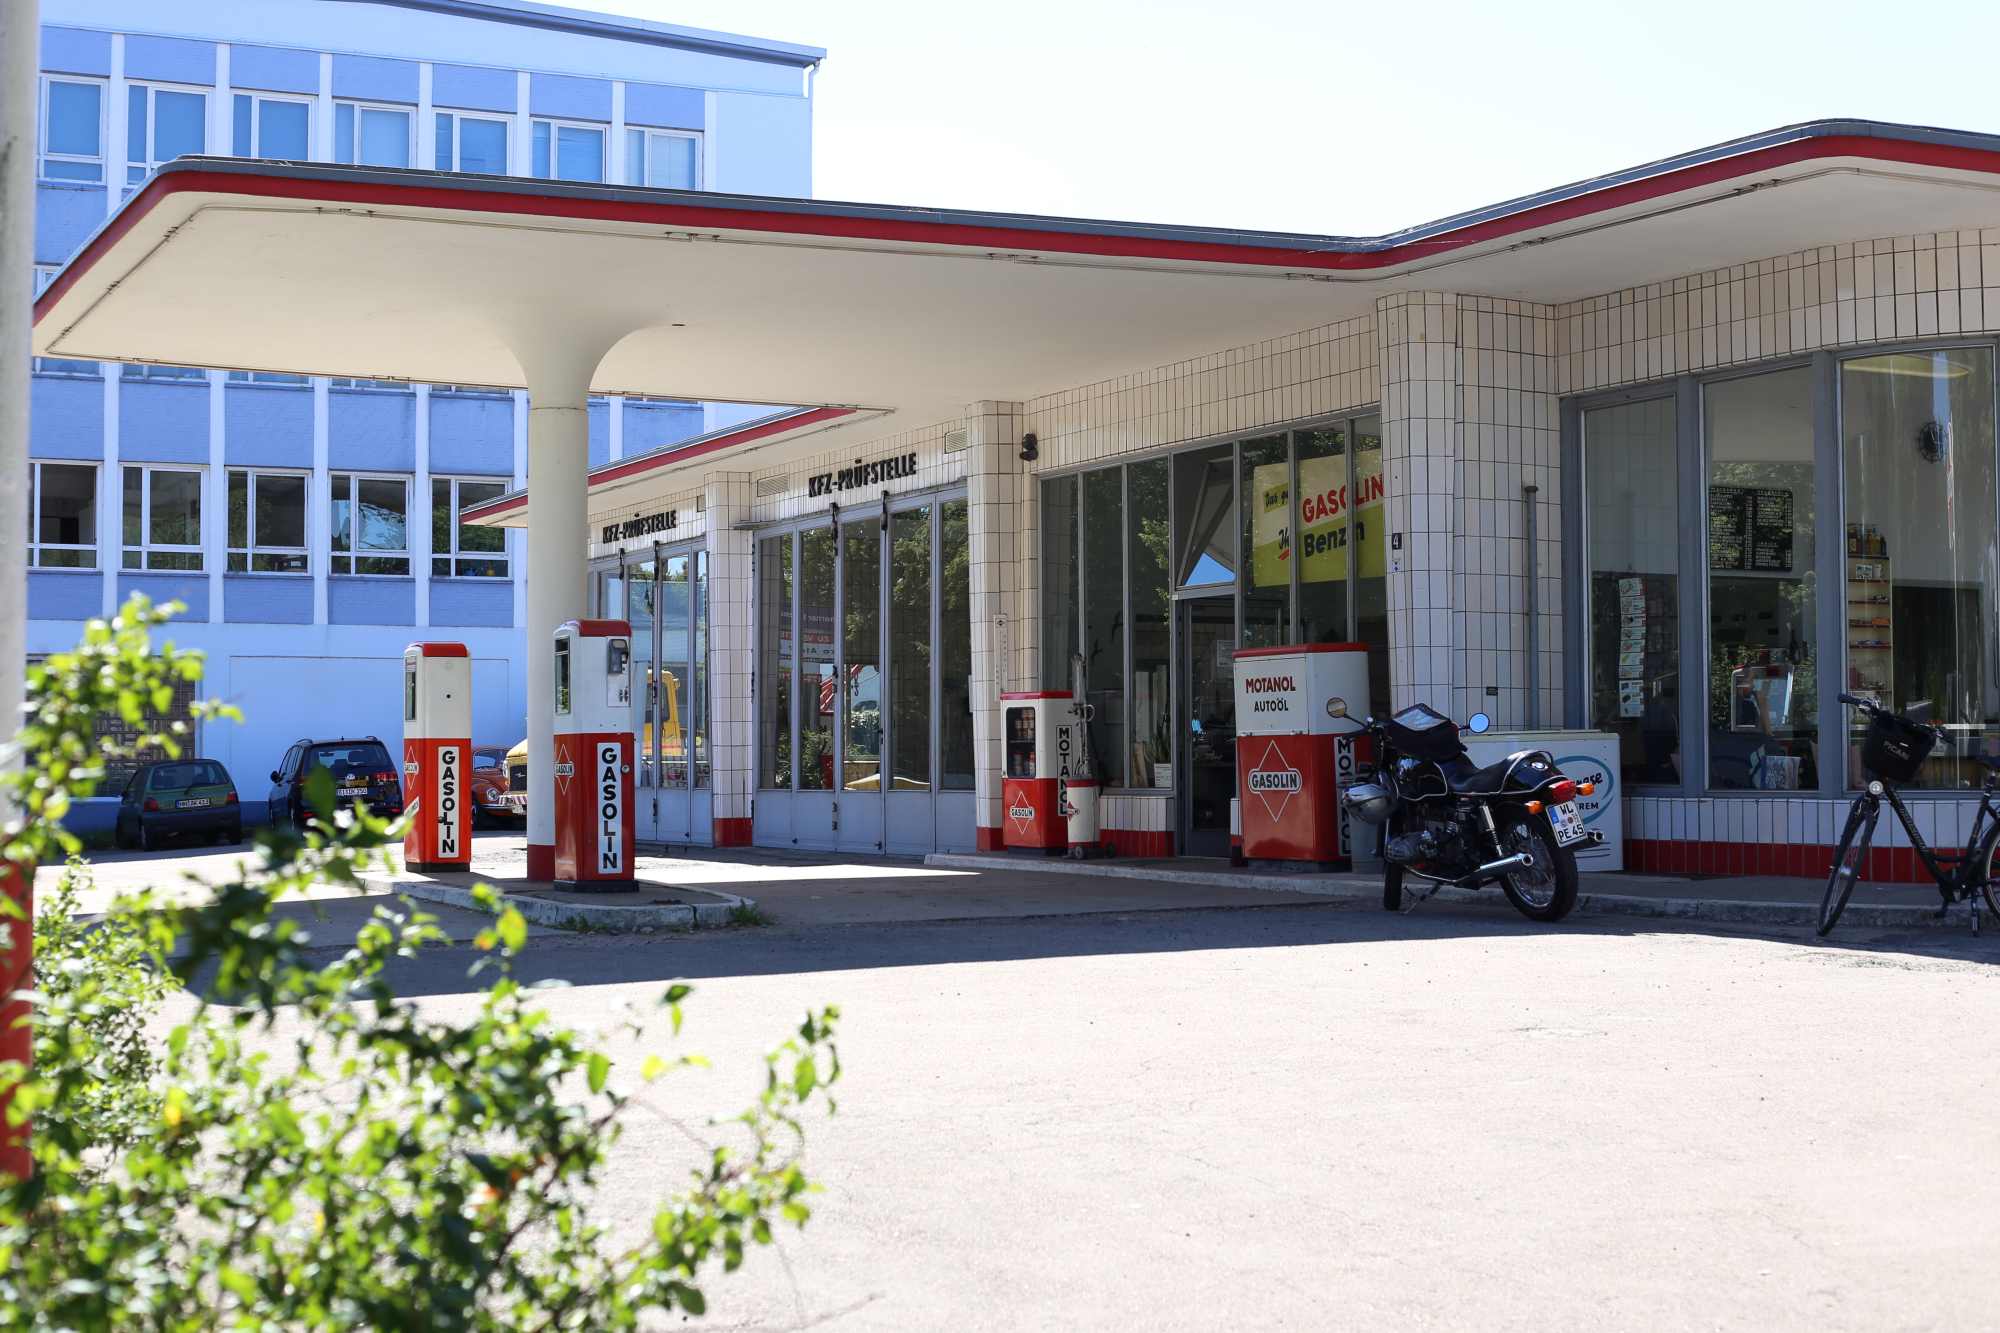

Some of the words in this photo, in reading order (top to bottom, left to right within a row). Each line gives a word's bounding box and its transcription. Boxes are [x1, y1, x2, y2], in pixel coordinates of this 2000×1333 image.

[808, 452, 917, 498] KFZ-PRÜFSTELLE
[602, 510, 677, 544] KFZ-PRÜFSTELLE
[1303, 521, 1365, 558] Benzn
[1245, 676, 1297, 694] MOTANOL
[1254, 697, 1289, 713] AUTOÖL
[1251, 773, 1298, 789] GASOLIN
[441, 750, 456, 853] GASOLIN
[601, 747, 617, 869] GASOLIN
[1559, 803, 1574, 815] WL
[1011, 808, 1033, 817] GASOLIN
[1557, 828, 1572, 841] PE
[1572, 823, 1584, 836] 45
